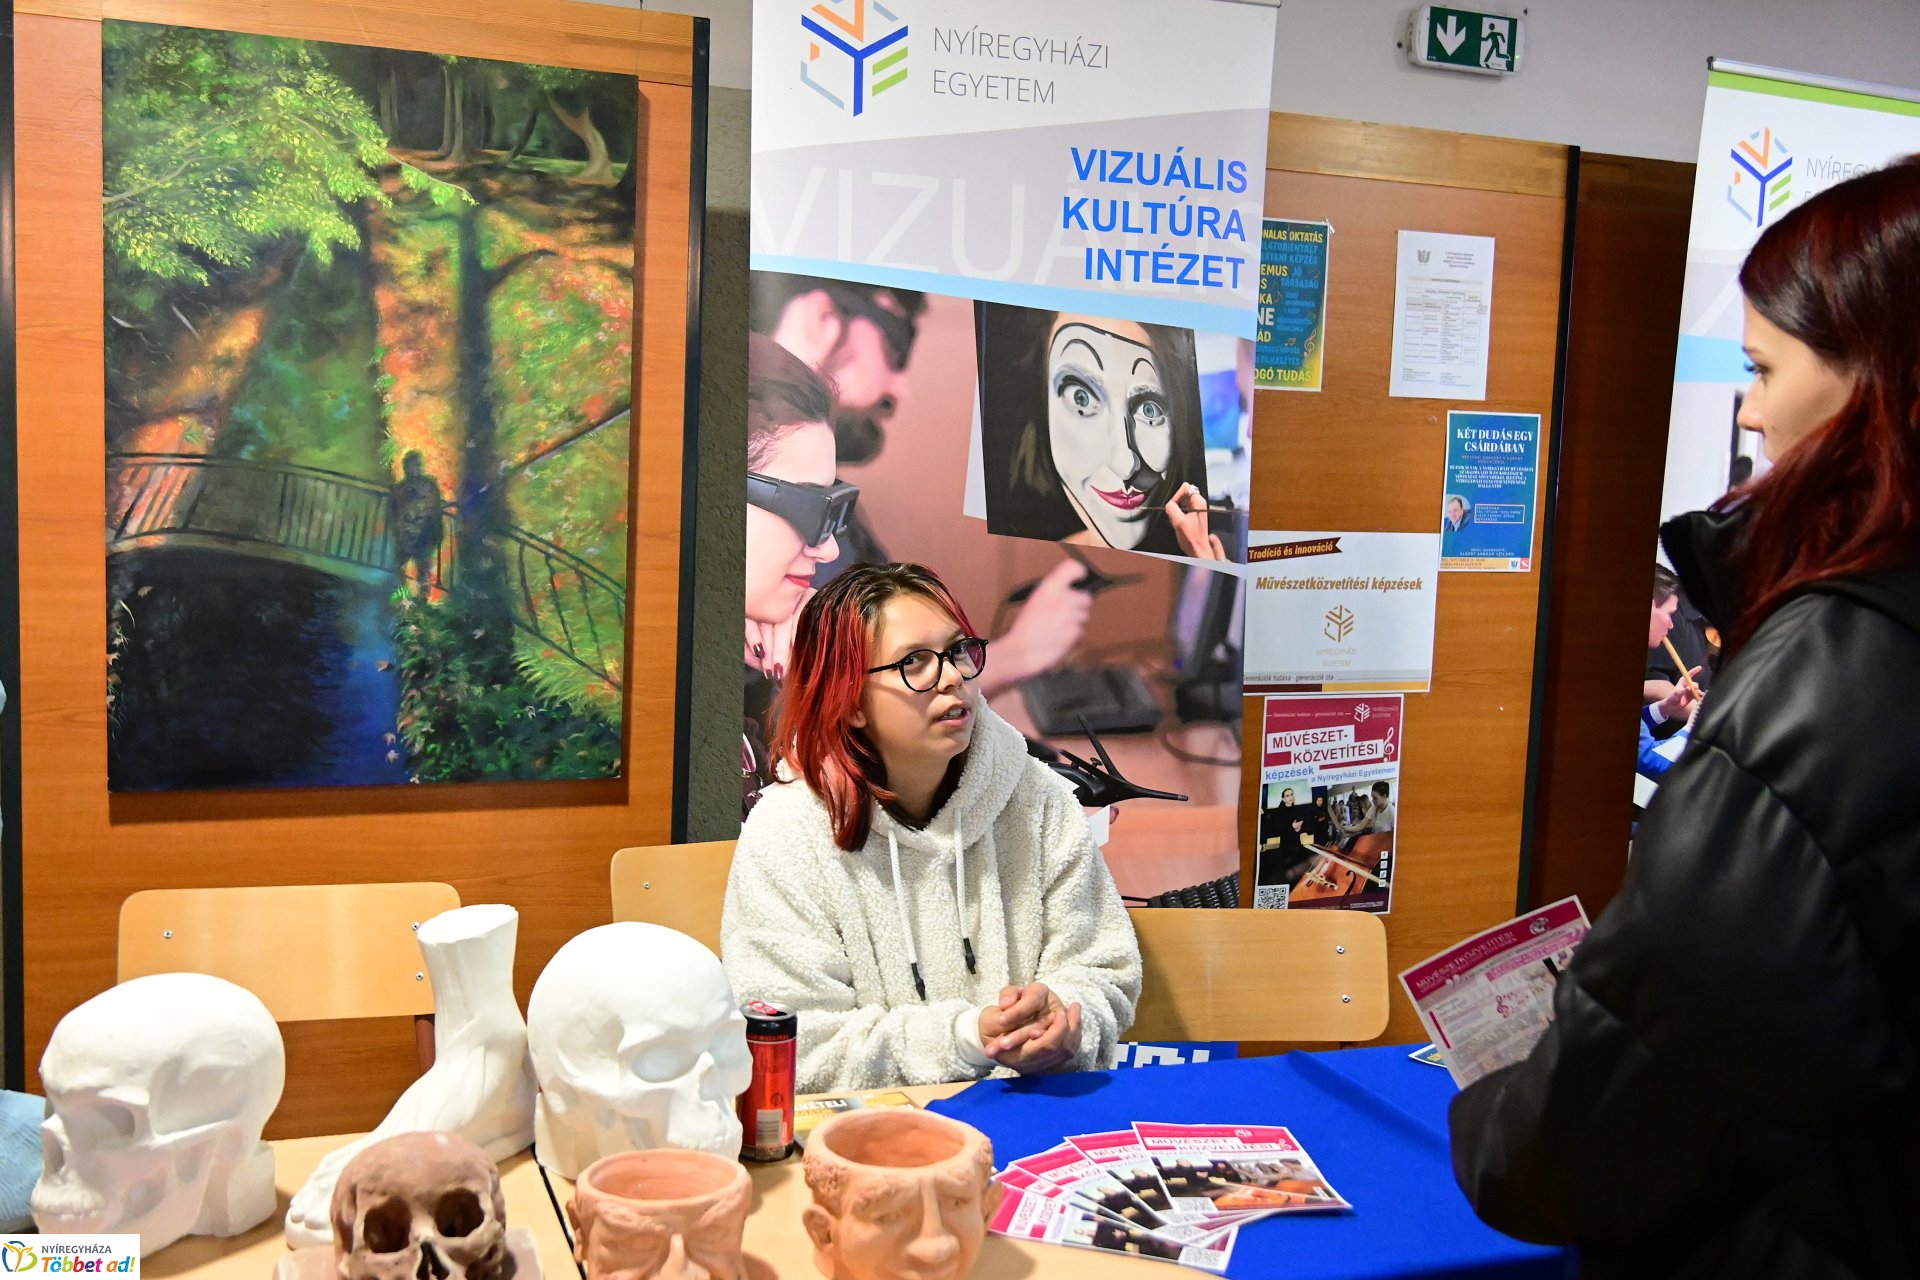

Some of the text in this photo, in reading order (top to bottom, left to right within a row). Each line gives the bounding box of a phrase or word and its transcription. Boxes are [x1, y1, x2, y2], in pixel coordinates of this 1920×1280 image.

[933, 25, 1109, 69] NYÍREGYHÁZI
[933, 69, 1055, 104] EGYETEM
[1070, 146, 1248, 193] VIZUÁLIS
[1062, 195, 1247, 242] KULTÚRA
[1262, 229, 1323, 243] NALAS OKTATÁS
[1084, 243, 1246, 289] INTÉZET
[1260, 264, 1288, 276] EMUS
[1277, 368, 1312, 382] TUDÁS
[1457, 427, 1534, 441] KÉT DUDÁS EGY
[1464, 440, 1525, 453] CSÁRDÁBAN
[1283, 545, 1293, 556] és
[1295, 541, 1333, 555] innováció
[1255, 577, 1422, 593] Művészetközvetítési képzések
[1272, 729, 1348, 749] MŰVÉSZET-
[1293, 743, 1378, 765] KÖZVETÍTÉSI
[1265, 765, 1314, 782] képzések
